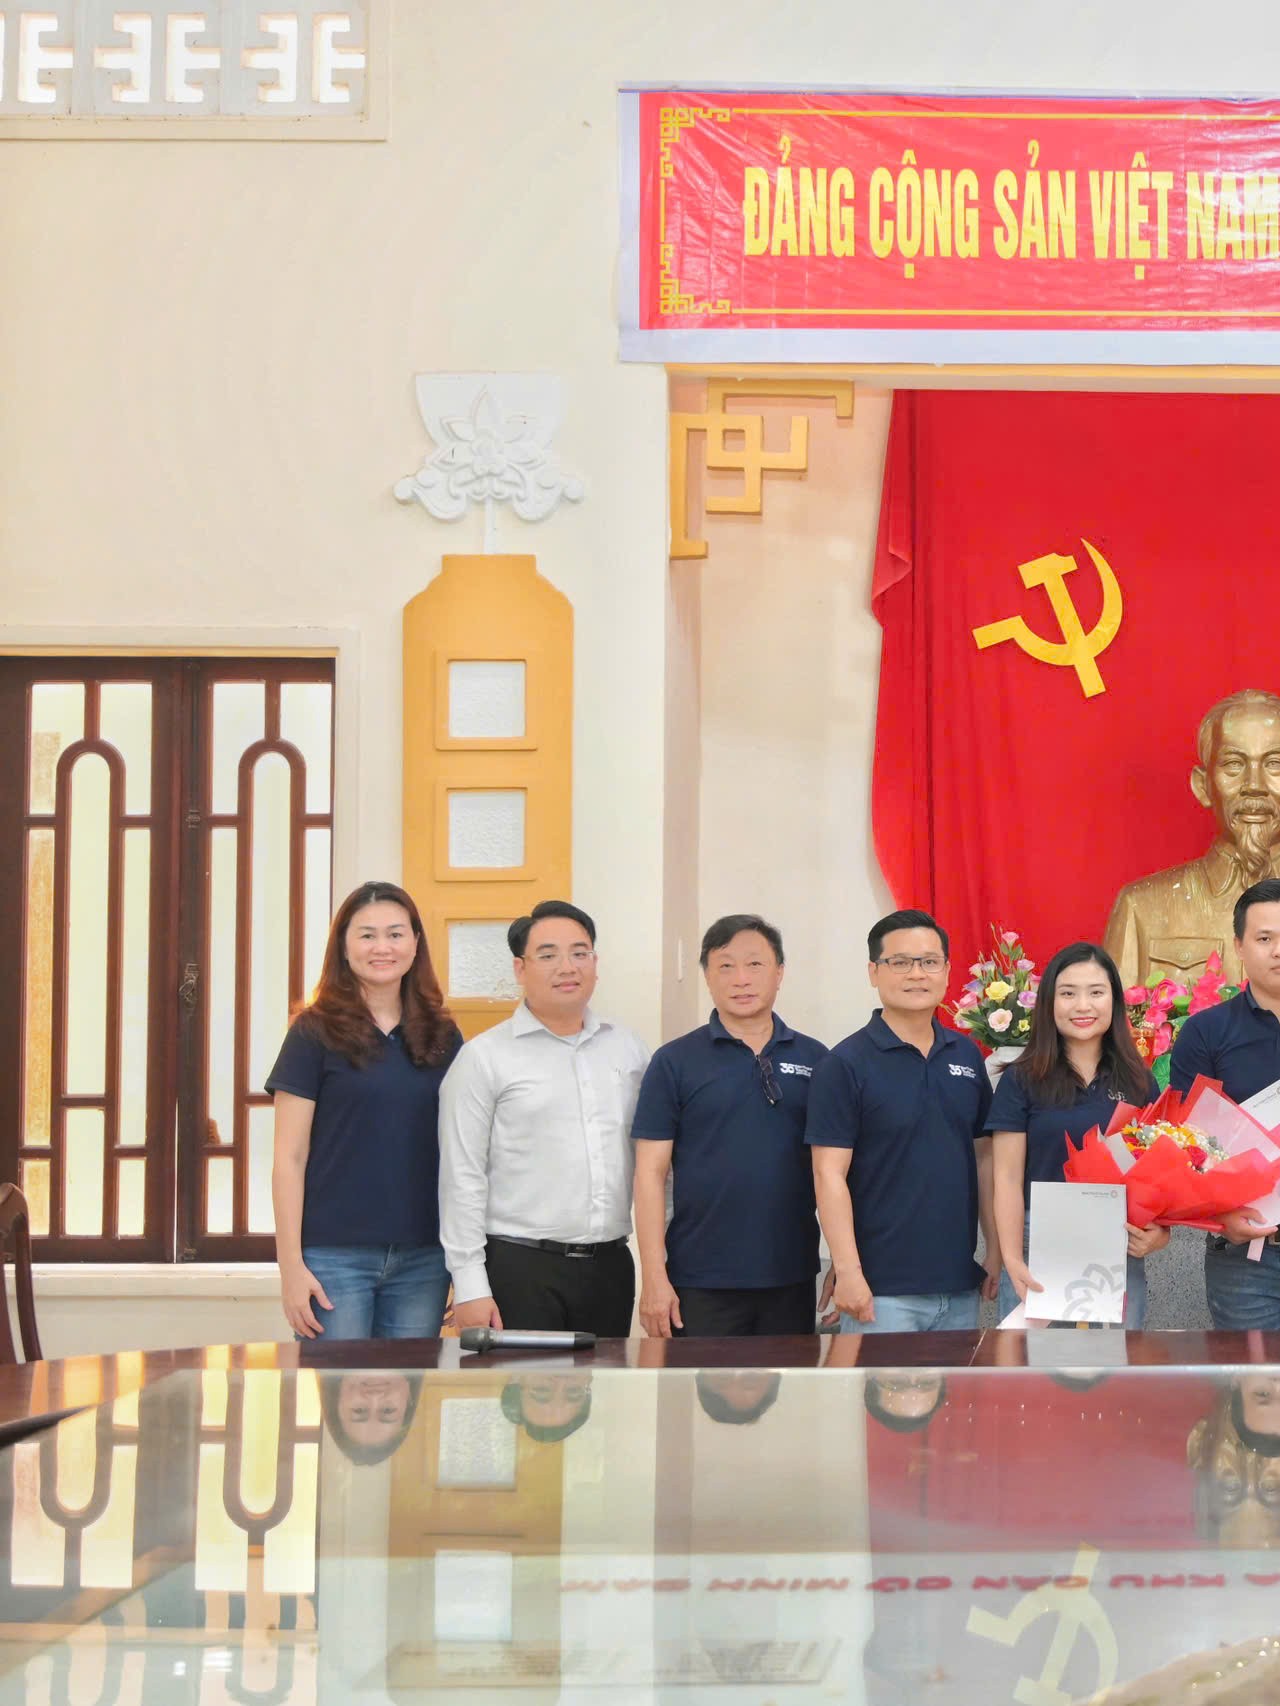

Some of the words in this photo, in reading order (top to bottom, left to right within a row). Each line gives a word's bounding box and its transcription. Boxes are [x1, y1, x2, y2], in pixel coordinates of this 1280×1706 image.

[742, 135, 855, 257] ĐẢNG
[868, 149, 979, 279] CỘNG
[993, 139, 1076, 259] SẢN
[1088, 152, 1173, 280] VIỆT
[1186, 171, 1279, 260] NAM
